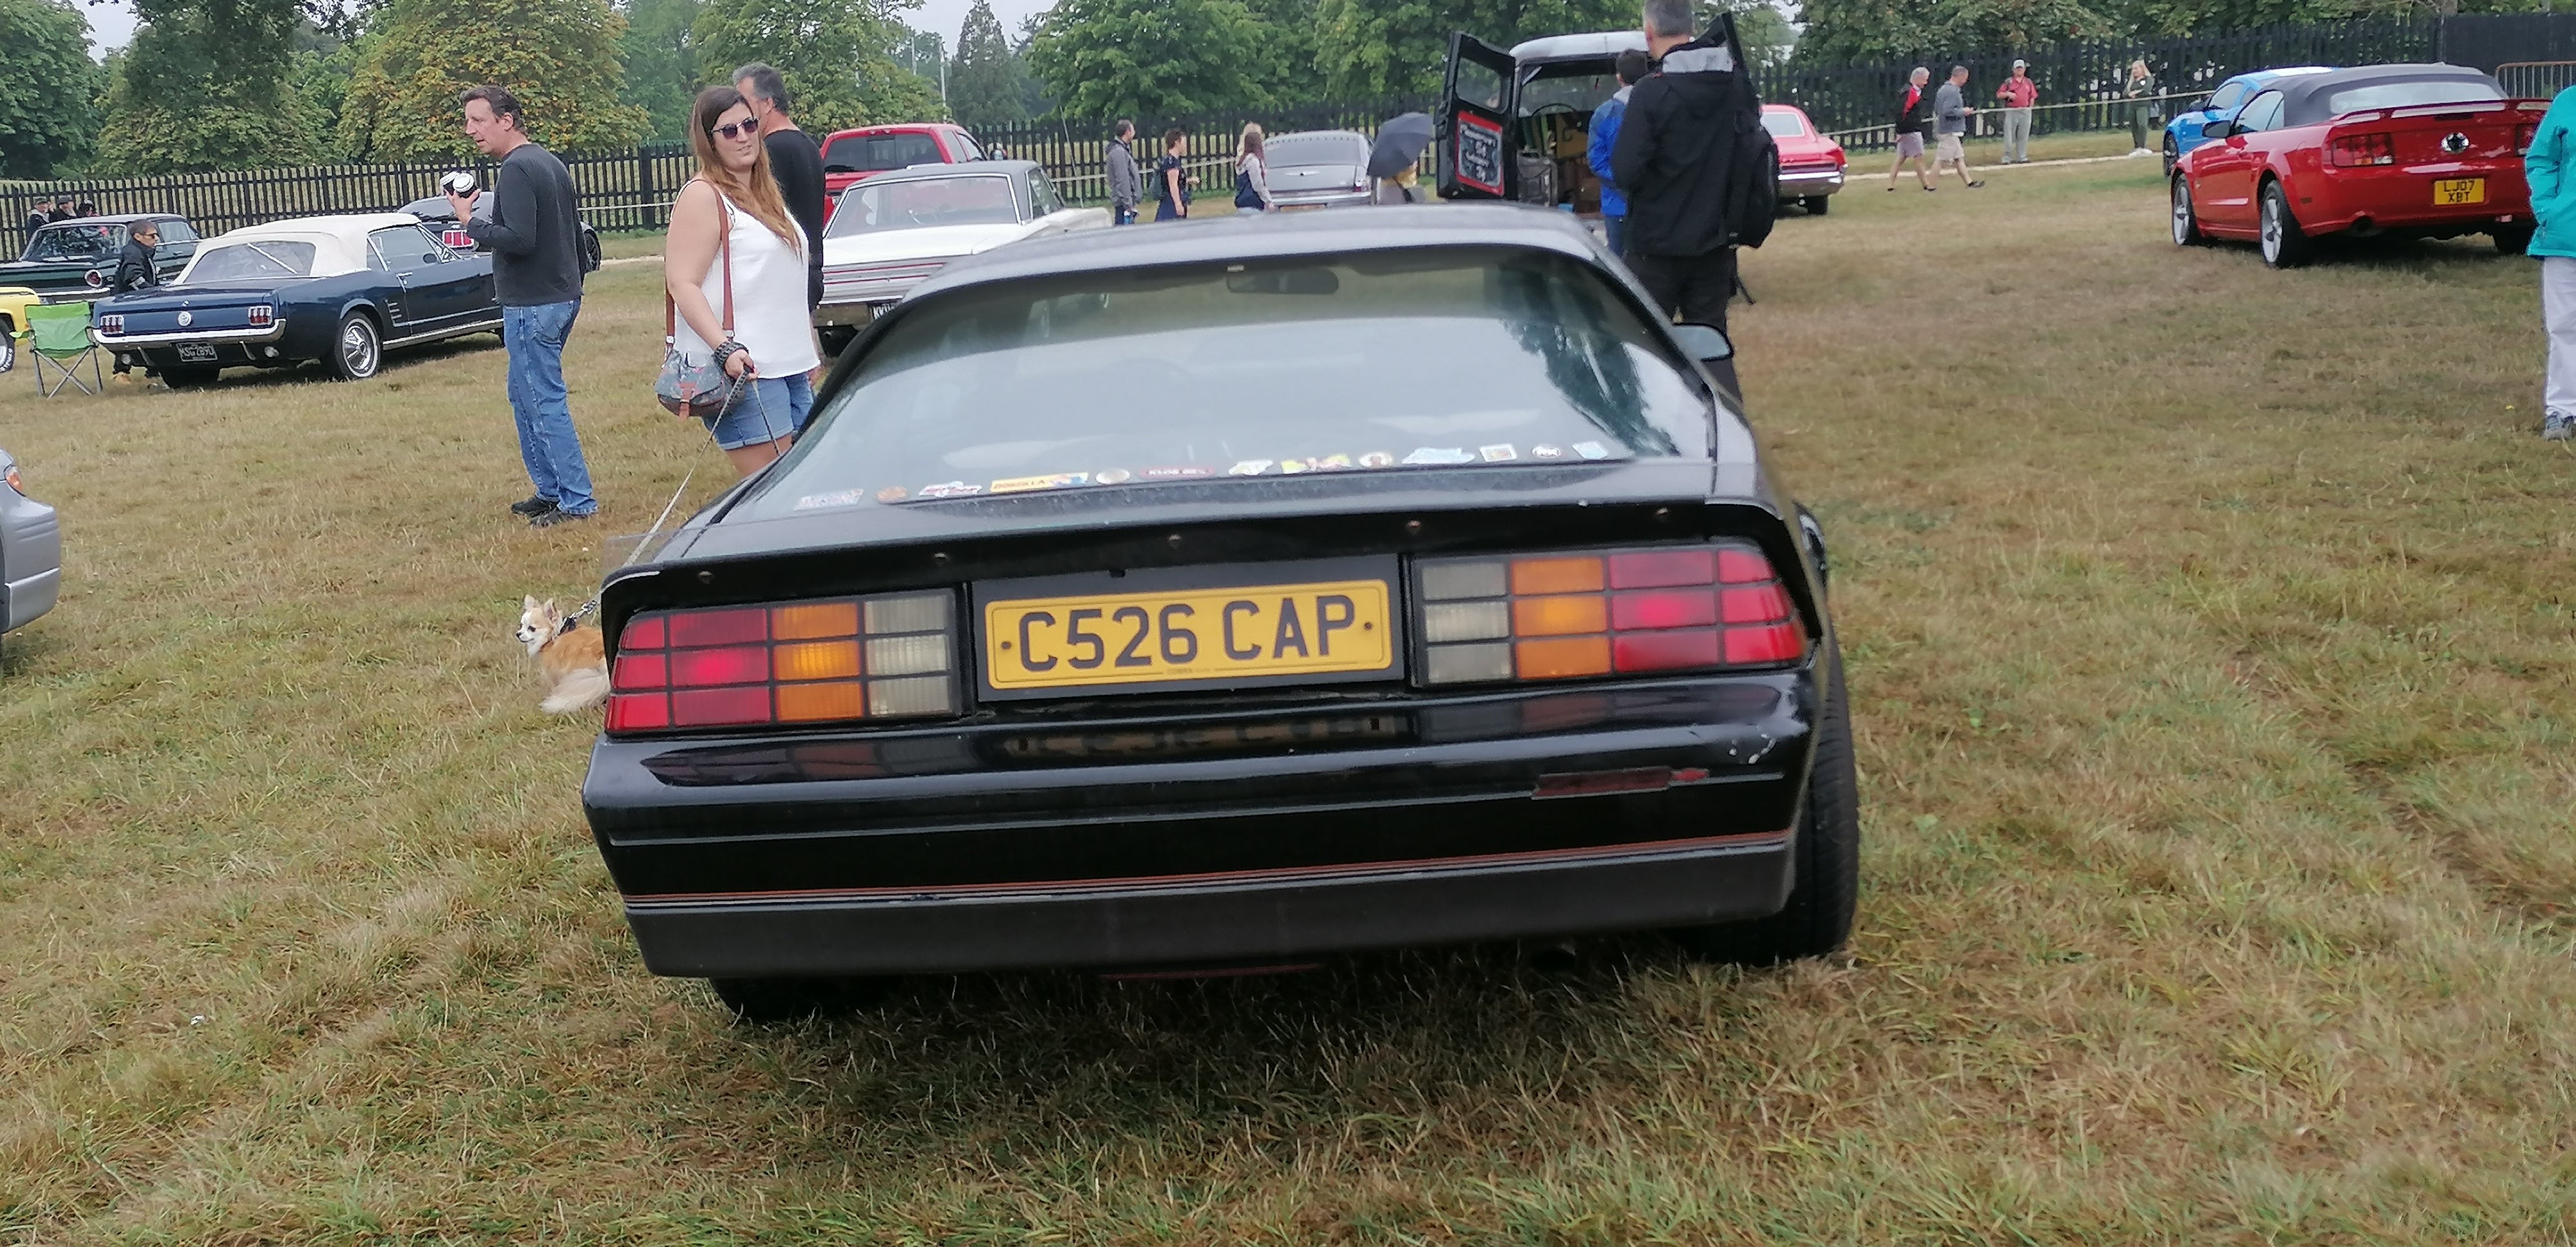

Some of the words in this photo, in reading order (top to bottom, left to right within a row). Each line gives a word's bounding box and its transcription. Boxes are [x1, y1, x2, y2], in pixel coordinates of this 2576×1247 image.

[2443, 180, 2475, 192] LJ07
[2448, 191, 2470, 203] XBT
[1019, 604, 1198, 672] C526
[1222, 595, 1355, 661] CAP
